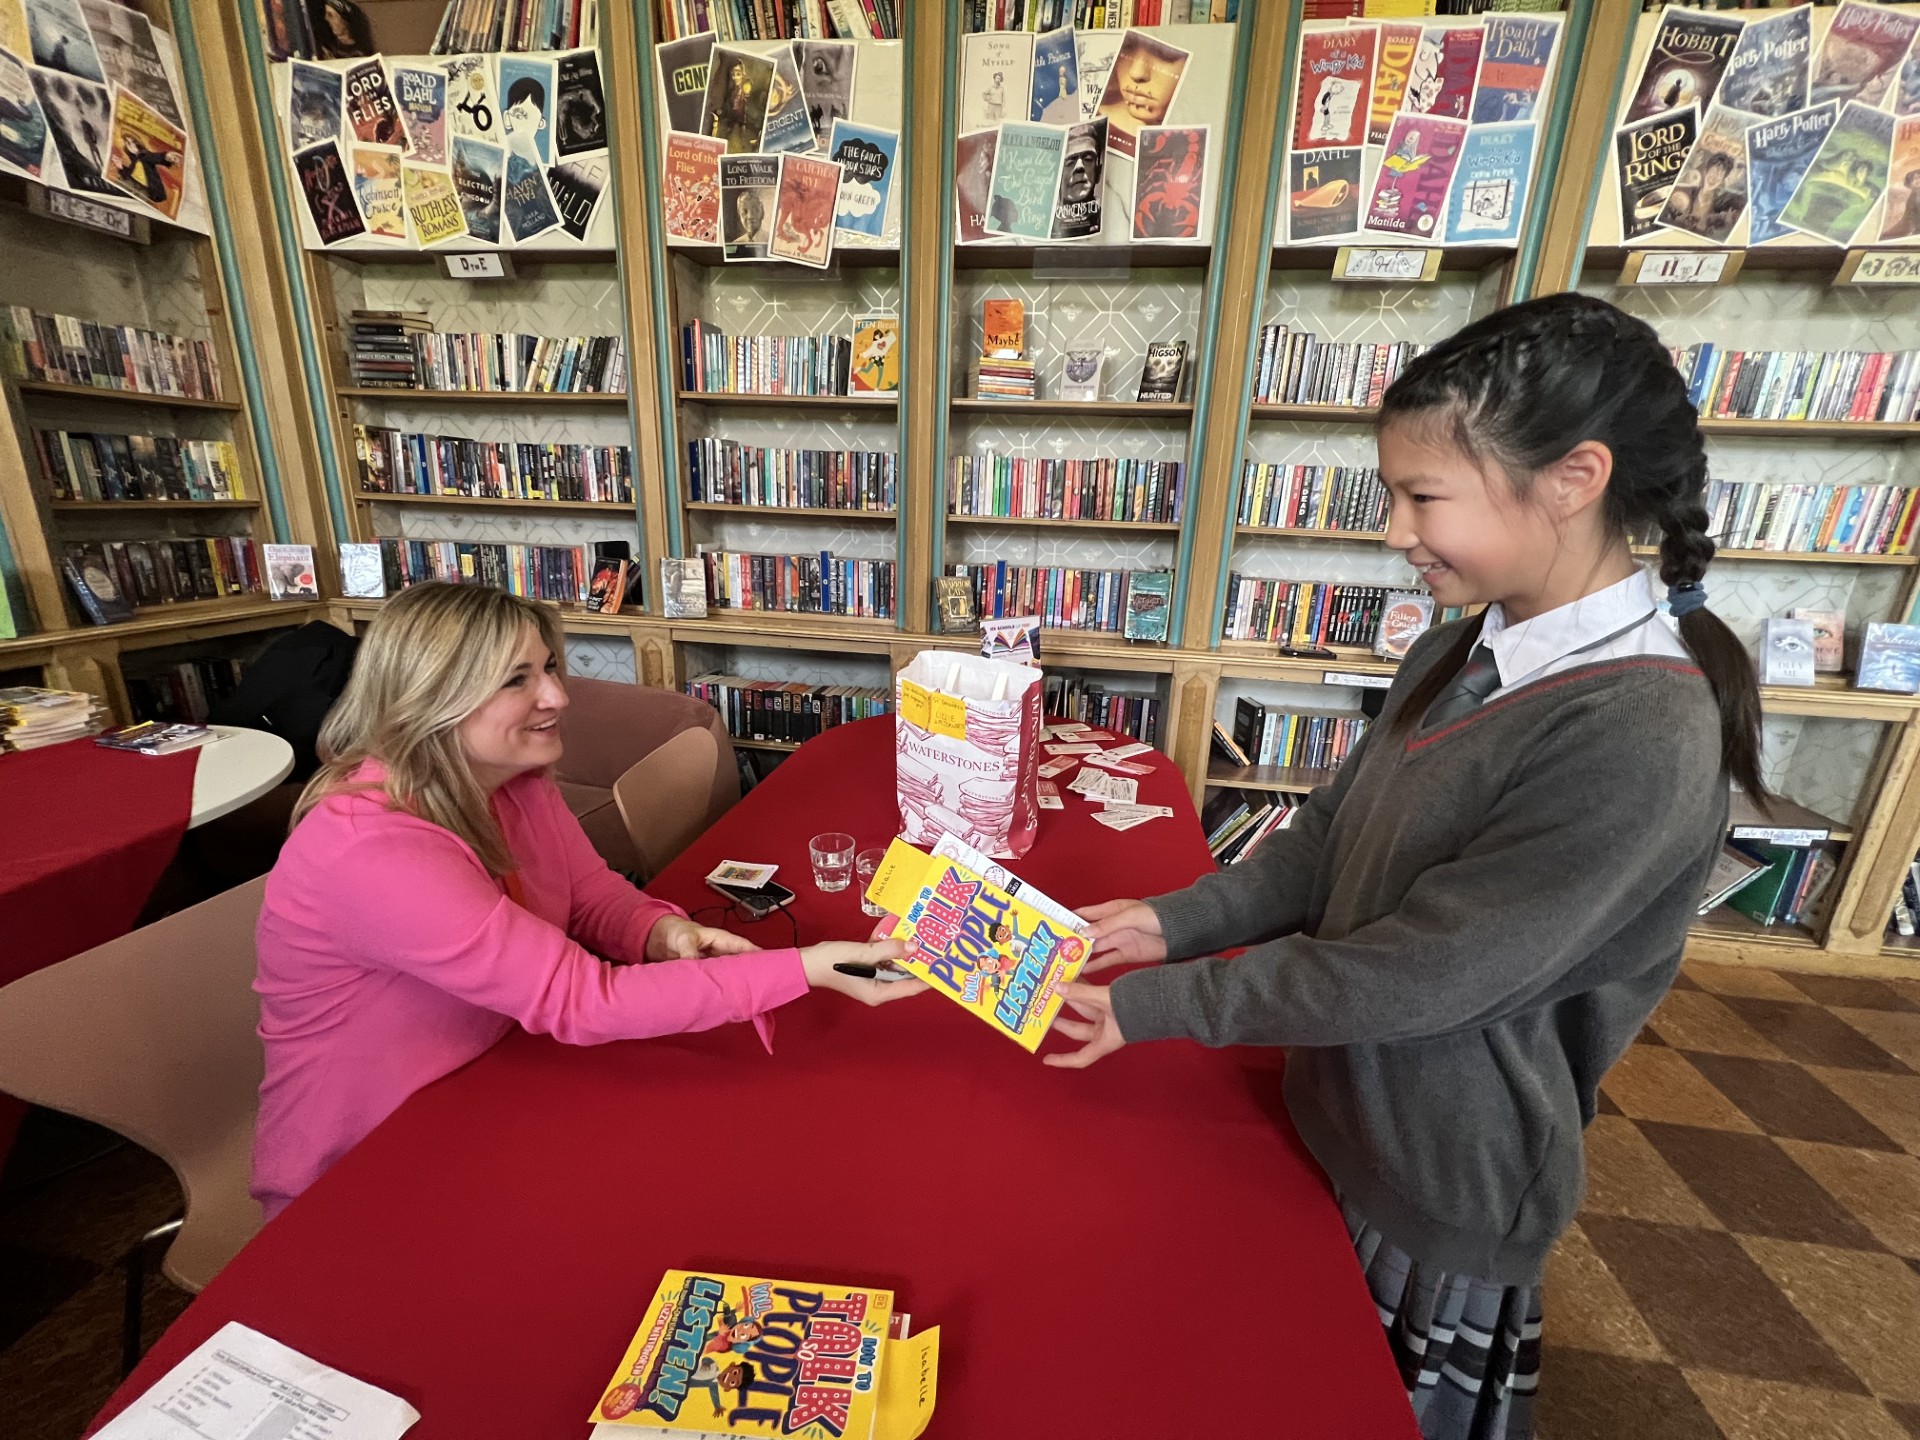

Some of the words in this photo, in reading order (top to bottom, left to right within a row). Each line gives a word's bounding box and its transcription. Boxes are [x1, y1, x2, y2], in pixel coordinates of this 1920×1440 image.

[1489, 19, 1540, 42] Roald
[1838, 8, 1876, 30] Harry
[1873, 12, 1916, 39] Potter
[1323, 35, 1361, 49] DIARY
[1386, 36, 1416, 44] ROALD
[1495, 38, 1538, 59] Dahl
[1657, 25, 1738, 59] HOBBIT
[1764, 36, 1809, 63] Potter
[982, 59, 1015, 67] MYSELF
[1309, 57, 1346, 75] Wimpy
[1346, 53, 1366, 71] Kid
[346, 73, 382, 100] LORD
[402, 72, 436, 88] ROALD
[403, 85, 437, 105] DAHL
[352, 96, 391, 126] FLIES
[1754, 121, 1792, 149] Harry
[1792, 112, 1832, 135] Potter
[1629, 122, 1686, 163] LORD
[1648, 148, 1662, 159] OF
[1662, 142, 1682, 154] THE
[669, 147, 690, 160] Lord
[692, 151, 703, 162] of
[702, 153, 718, 166] the
[843, 145, 860, 158] THE
[860, 149, 882, 165] FAULT
[1006, 149, 1034, 173] Know
[1303, 149, 1350, 166] DAHL
[1468, 155, 1501, 169] Wimpy
[1503, 151, 1522, 164] Kid
[1625, 145, 1692, 186] RINGS
[676, 161, 696, 174] Flies
[727, 164, 748, 174] LONG
[750, 163, 773, 174] WALK
[796, 160, 836, 179] CATCHER
[859, 162, 883, 179] STARS
[458, 178, 493, 194] ELECTRIC
[506, 175, 538, 200] HAVEN
[726, 177, 737, 186] TO
[739, 175, 776, 186] FREEDOM
[1023, 167, 1055, 190] Caged
[359, 184, 400, 205] Robinson
[854, 193, 876, 206] GREEN
[1016, 186, 1045, 206] Bird
[410, 192, 460, 226] RUTHLESS
[421, 215, 460, 237] ROMANS
[1368, 214, 1406, 229] Matilda
[460, 257, 469, 270] D
[478, 257, 488, 270] E
[857, 320, 876, 329] TEEN
[987, 333, 1020, 347] Maybe
[1149, 348, 1183, 357] HIGSON
[1140, 391, 1172, 400] HUNTED
[1390, 610, 1417, 622] Fallen
[908, 741, 1000, 773] WATERSTONES
[907, 901, 926, 925] HOW
[918, 886, 933, 901] TO
[903, 867, 979, 966] TALK
[928, 886, 1012, 993] PEOPLE
[945, 922, 961, 941] SO
[960, 971, 981, 1003] WILL
[995, 924, 1057, 1031] LISTEN!
[749, 1282, 774, 1320] WILL
[648, 1279, 723, 1415] LISTEN!
[797, 1341, 819, 1361] SO
[858, 1336, 878, 1367] HOW
[727, 1286, 824, 1431] PEOPLE
[788, 1292, 868, 1430] TALK
[854, 1371, 872, 1391] TO
[917, 1345, 931, 1408] Isabelle
